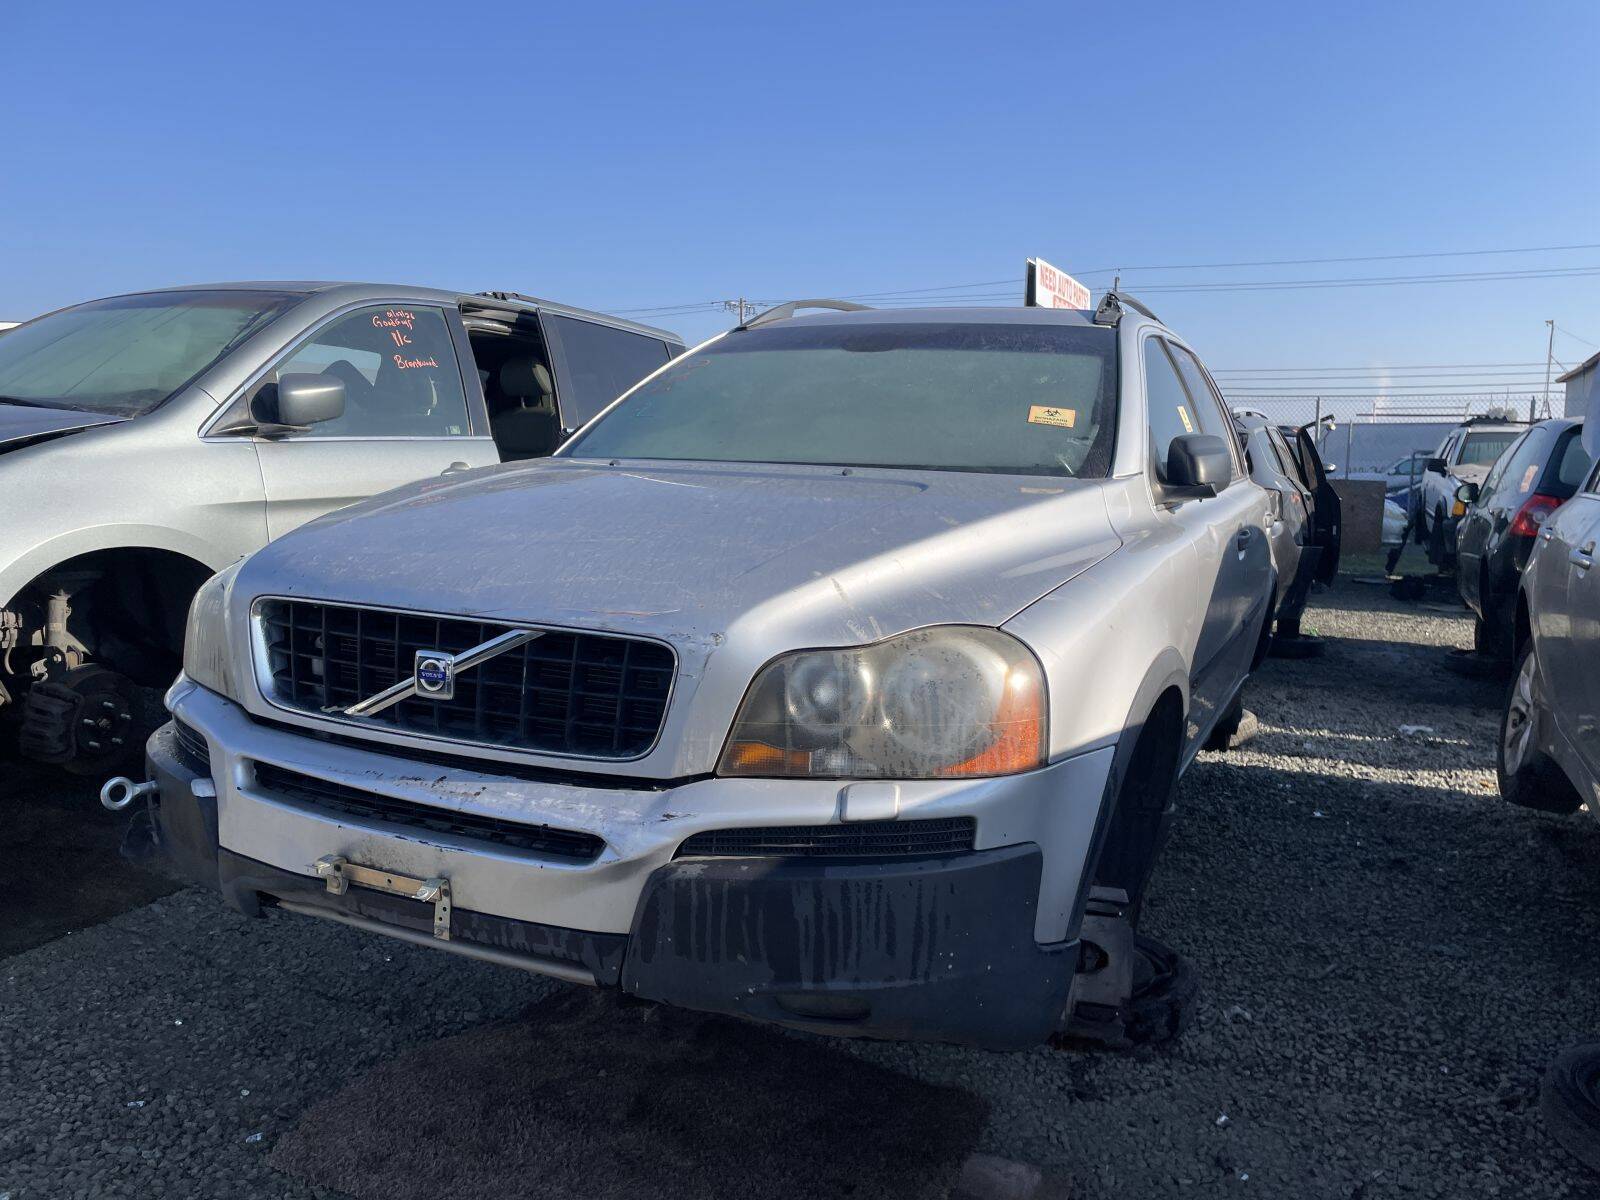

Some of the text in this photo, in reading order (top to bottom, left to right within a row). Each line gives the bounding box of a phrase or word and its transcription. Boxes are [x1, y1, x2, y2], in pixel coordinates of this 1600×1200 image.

[1040, 263, 1057, 293] NEED
[1058, 274, 1073, 302] AUTO
[421, 671, 443, 679] VOLVO
